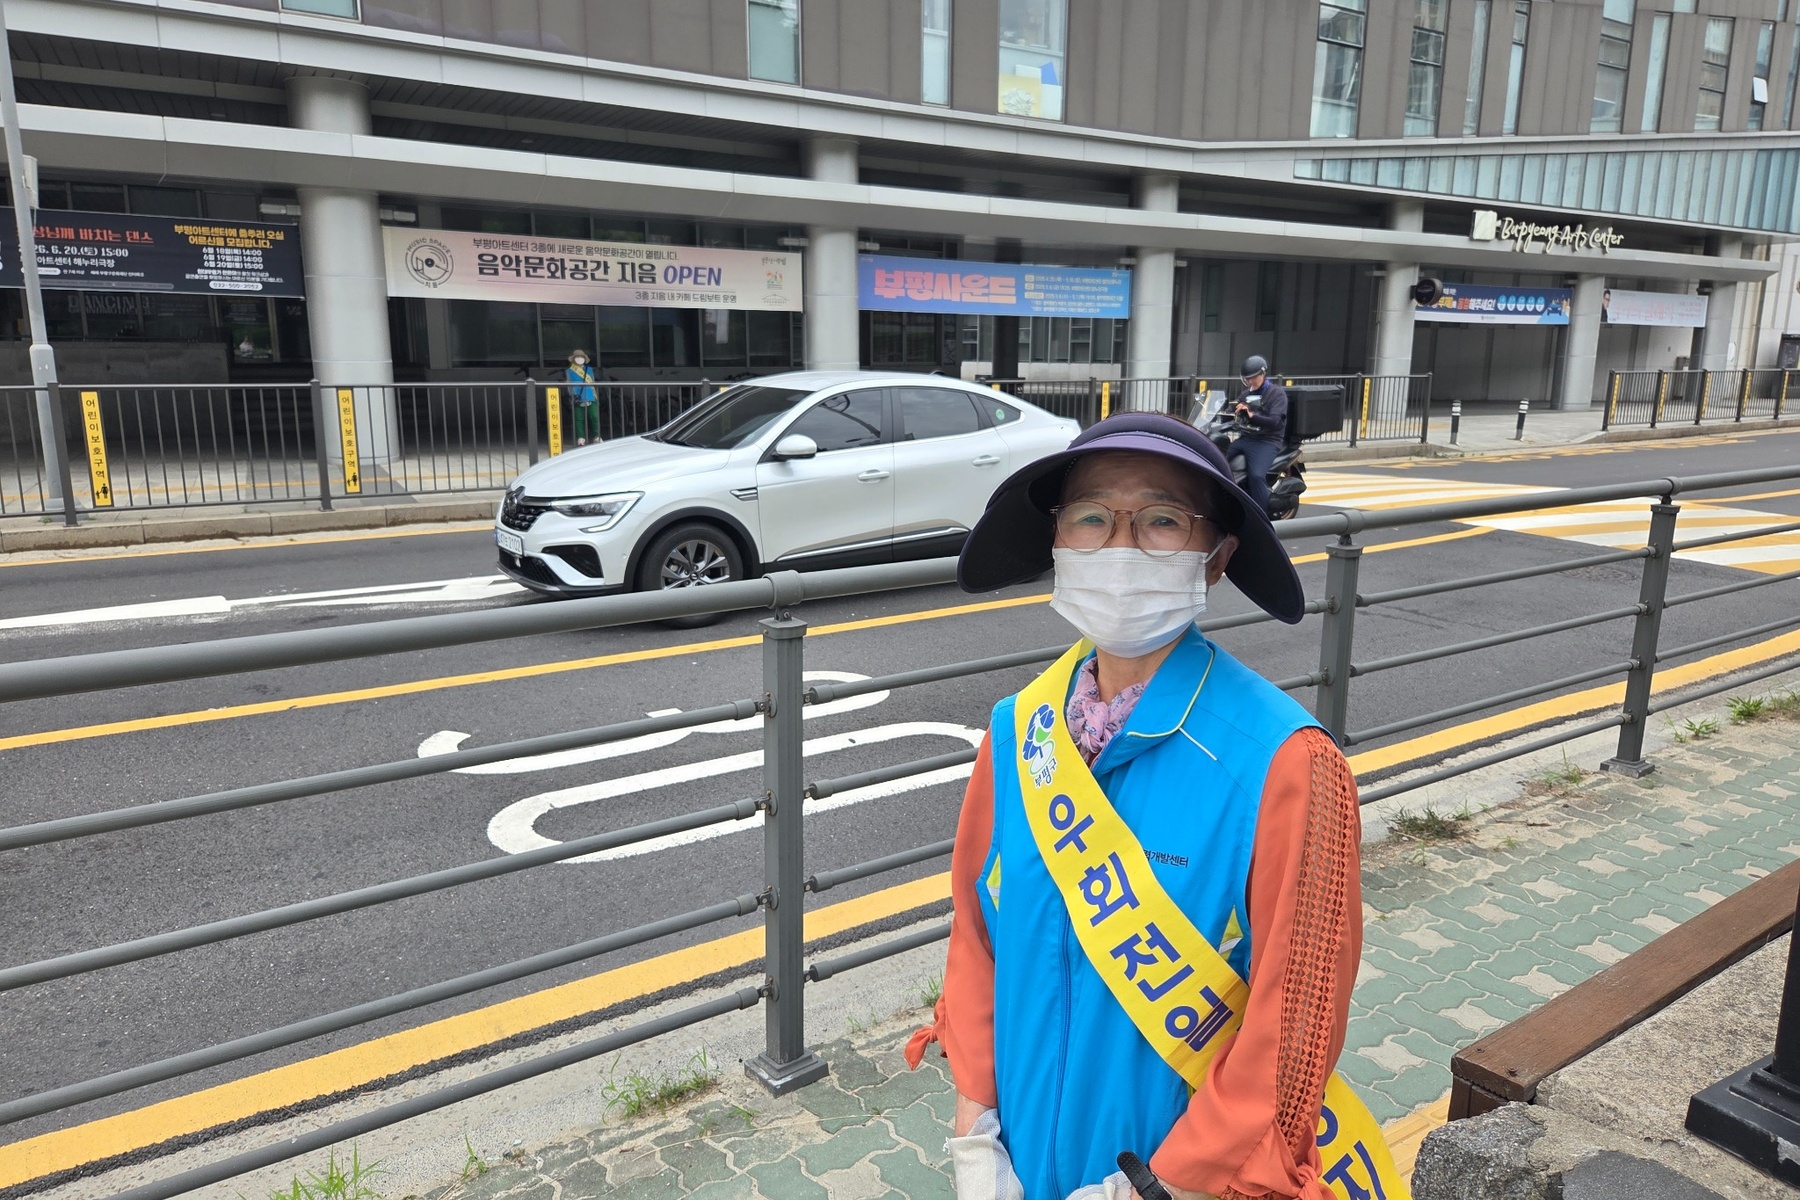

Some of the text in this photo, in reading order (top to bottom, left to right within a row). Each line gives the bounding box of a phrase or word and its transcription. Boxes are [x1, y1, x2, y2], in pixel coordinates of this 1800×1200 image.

[79, 228, 122, 242] 바치는
[126, 231, 154, 243] 댄스
[174, 225, 237, 238] 부평아트센터에
[267, 231, 285, 241] 오실
[189, 236, 273, 249] 어르신을 모집합니다.
[1501, 217, 1625, 254] Bupyeong Arts Center
[101, 248, 129, 258] 15:00
[407, 238, 451, 255] MUSIC SPACE
[472, 238, 679, 261] 부평아트센터 3층에 새로운 음악문화공간이 열립니다.
[477, 253, 722, 287] 음악문화공간 지음 OPEN
[635, 291, 737, 304] 3층 지음 내 카페 드림보트 운영
[874, 269, 1017, 304] 부평사운드
[84, 398, 106, 479] 어린이보호구역
[341, 396, 357, 468] 어린이보호구역
[1034, 757, 1057, 788] 부평구
